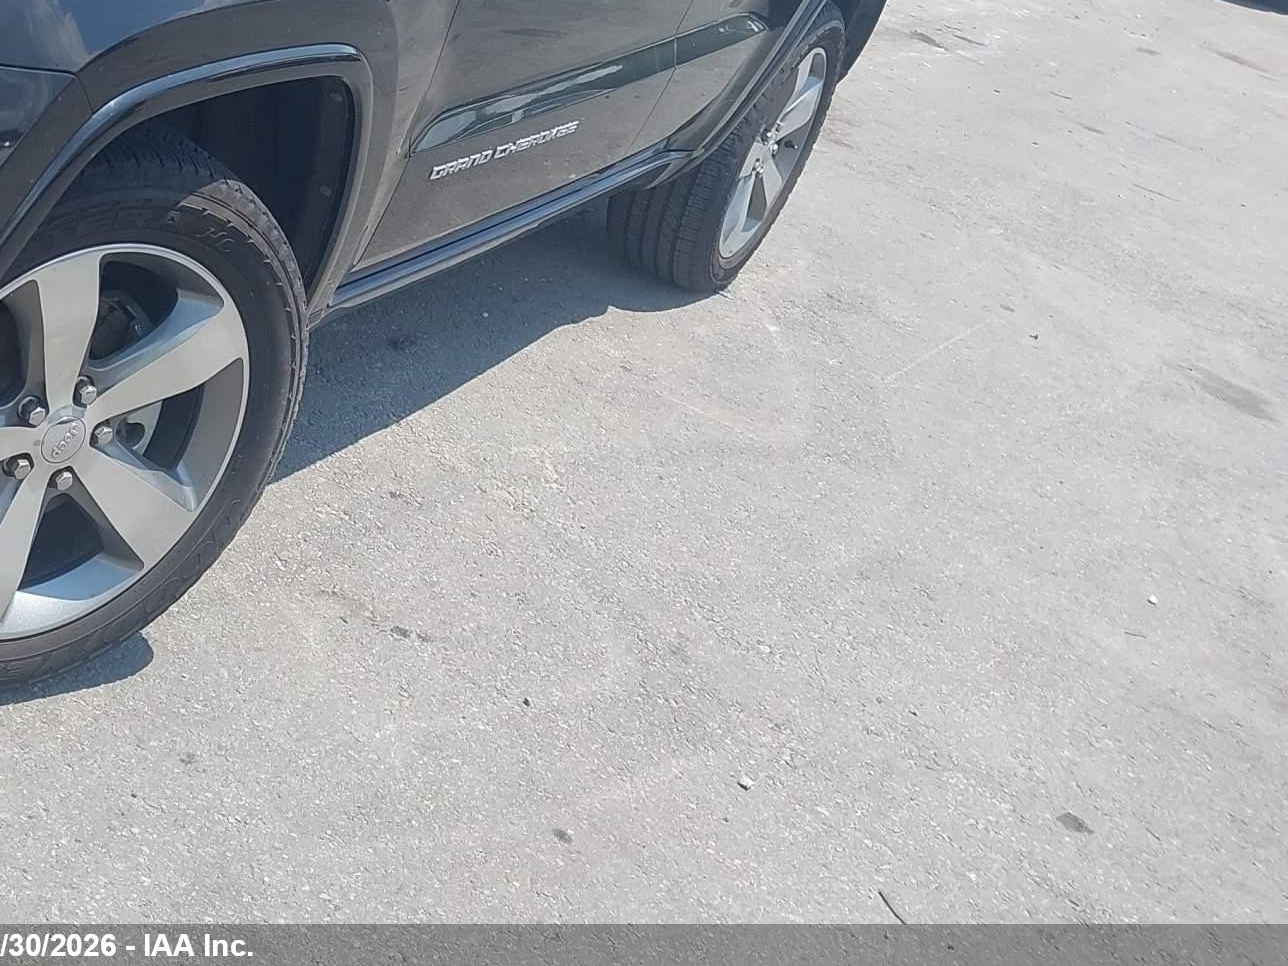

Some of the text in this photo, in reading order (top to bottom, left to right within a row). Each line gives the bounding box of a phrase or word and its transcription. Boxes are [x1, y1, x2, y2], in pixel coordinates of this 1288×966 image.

[429, 120, 580, 180] GRAND CHEROKEE
[51, 420, 80, 459] Jeep
